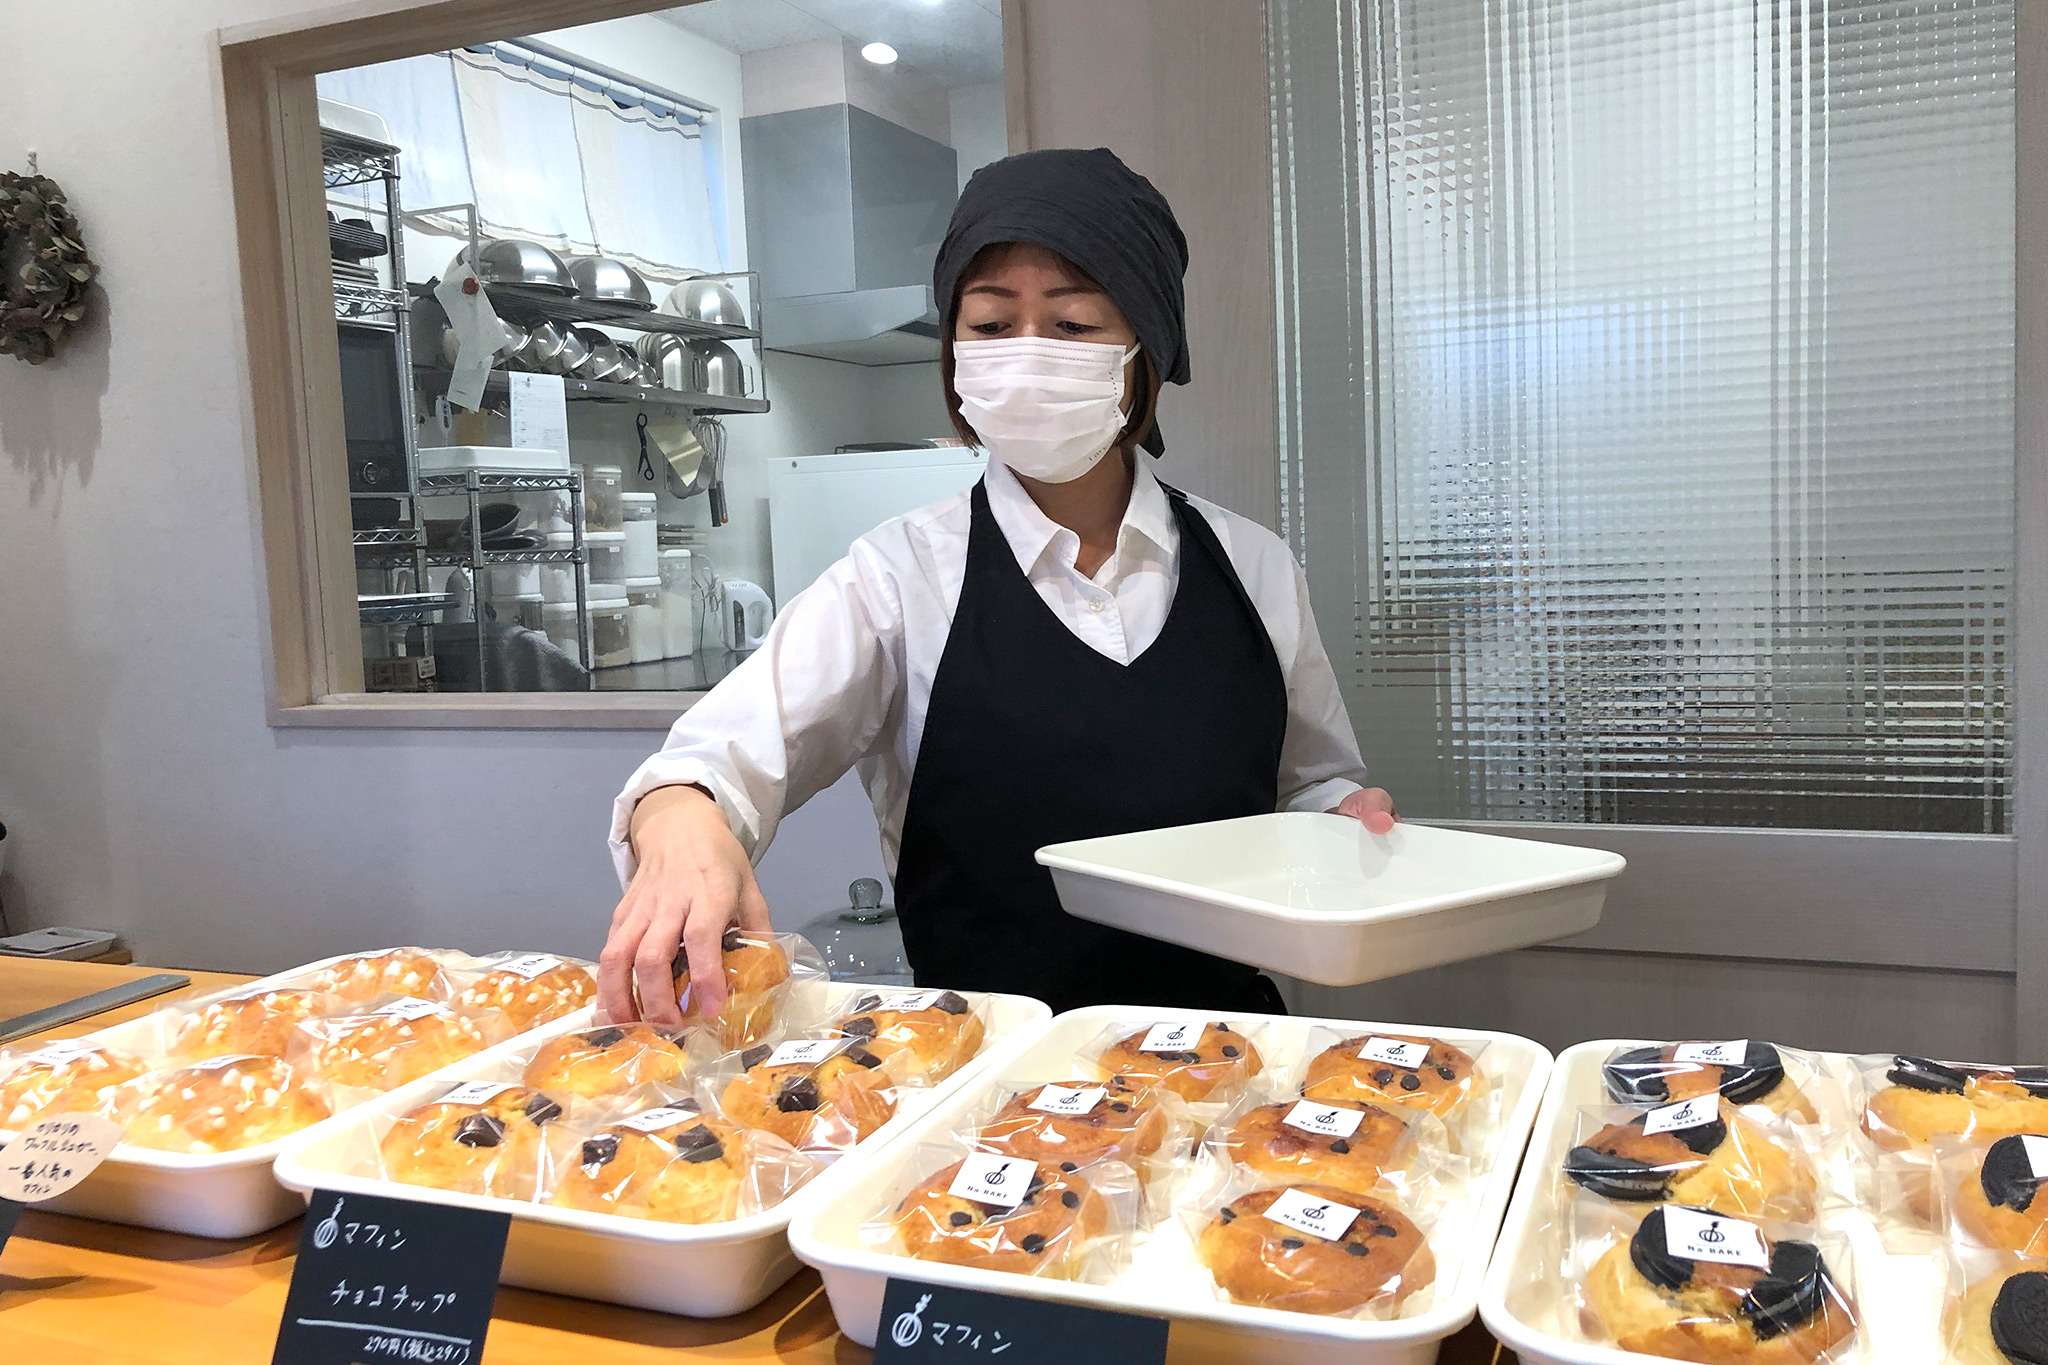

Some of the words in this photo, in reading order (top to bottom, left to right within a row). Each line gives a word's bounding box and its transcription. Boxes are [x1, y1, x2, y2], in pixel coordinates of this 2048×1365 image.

[345, 1222, 407, 1250] マフィン
[331, 1279, 457, 1314] チョコチップ
[932, 1322, 1012, 1353] マフィン
